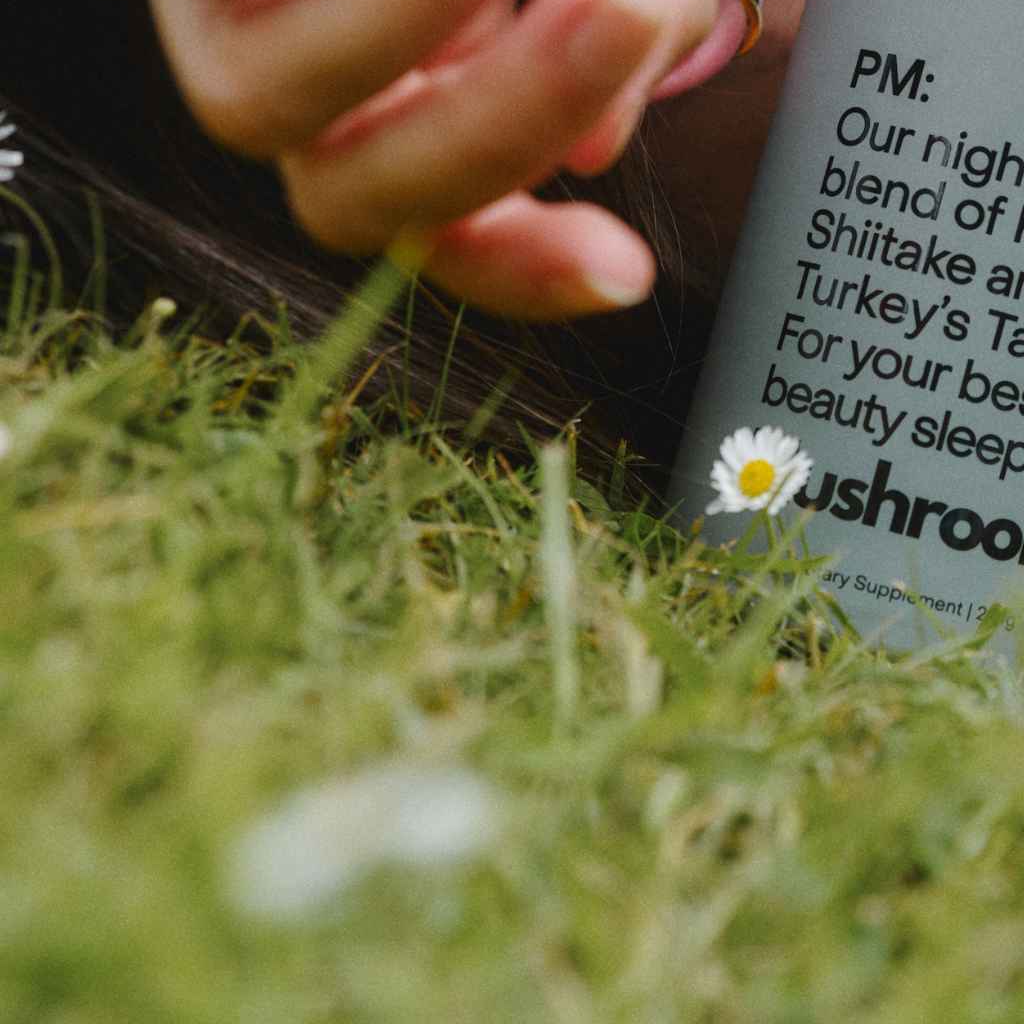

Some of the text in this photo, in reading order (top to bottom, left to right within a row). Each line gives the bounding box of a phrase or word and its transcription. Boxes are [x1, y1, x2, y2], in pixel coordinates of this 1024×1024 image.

[850, 49, 935, 103] PM:
[836, 107, 916, 156] Our
[820, 156, 947, 221] blend
[954, 195, 1008, 235] of
[807, 208, 977, 286] Shiitake
[796, 260, 971, 341] Turkey’s
[776, 312, 843, 363] For
[842, 339, 953, 392] your
[761, 363, 909, 447] beauty
